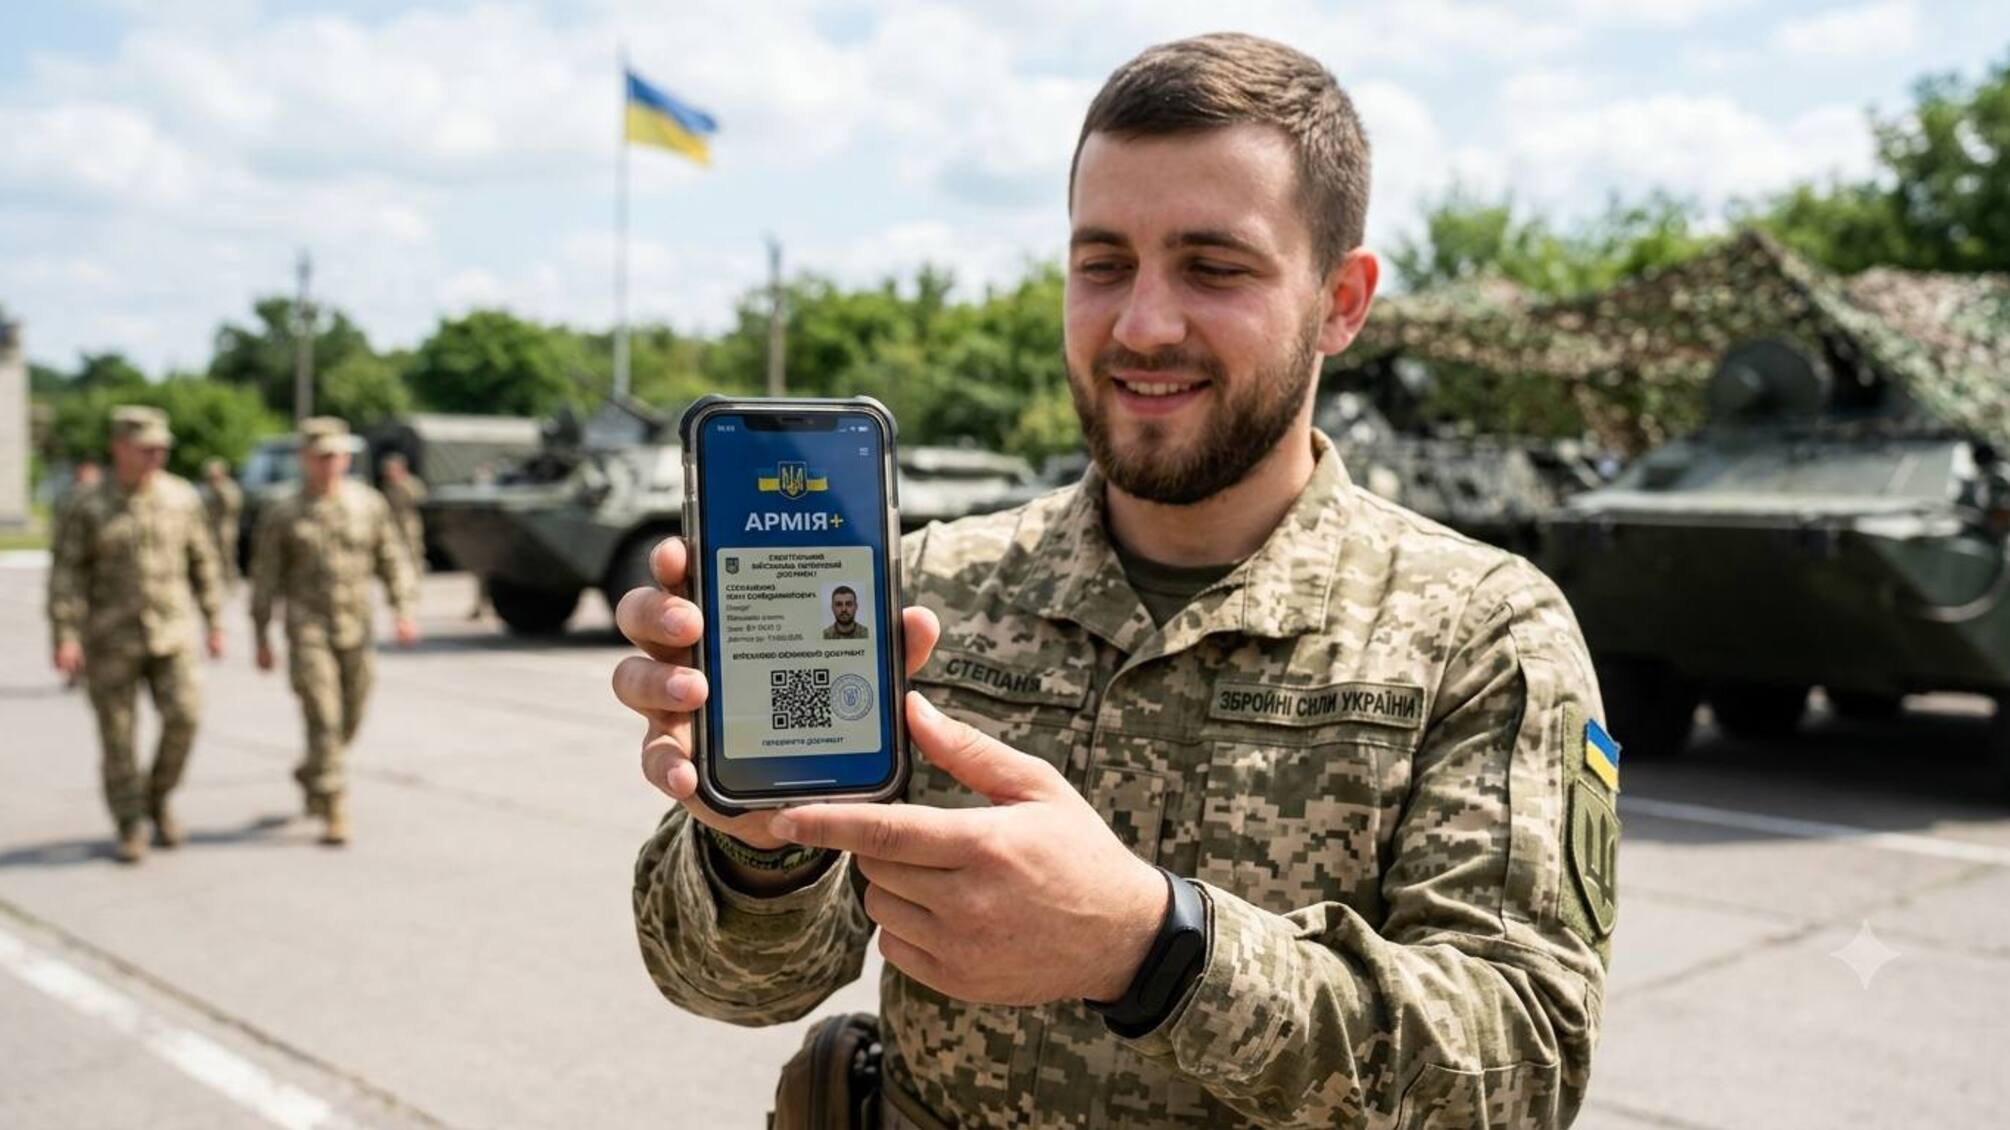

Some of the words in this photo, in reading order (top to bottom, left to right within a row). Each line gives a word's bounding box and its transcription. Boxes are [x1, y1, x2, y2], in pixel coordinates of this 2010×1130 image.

[745, 512, 844, 531] АРМІЯ+
[1219, 690, 1292, 716] ЗБРОЙНІ
[1296, 692, 1337, 717] СИЛИ
[1342, 690, 1415, 718] УКРАЇНИ
